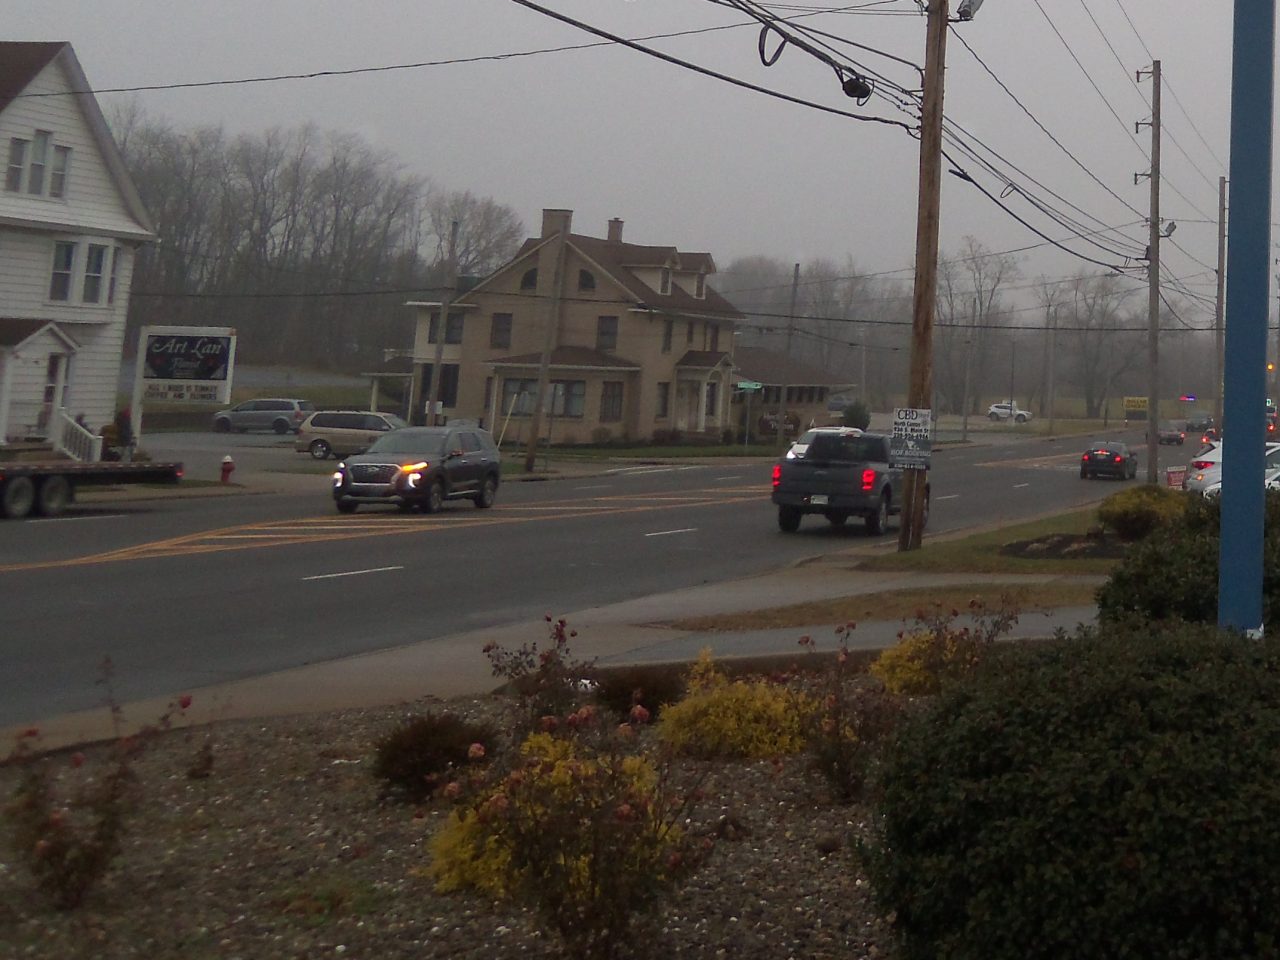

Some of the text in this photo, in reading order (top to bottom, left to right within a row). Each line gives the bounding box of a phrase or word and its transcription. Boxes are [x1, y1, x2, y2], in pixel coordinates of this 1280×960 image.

[152, 337, 222, 359] Art Lan
[898, 409, 918, 420] CBD
